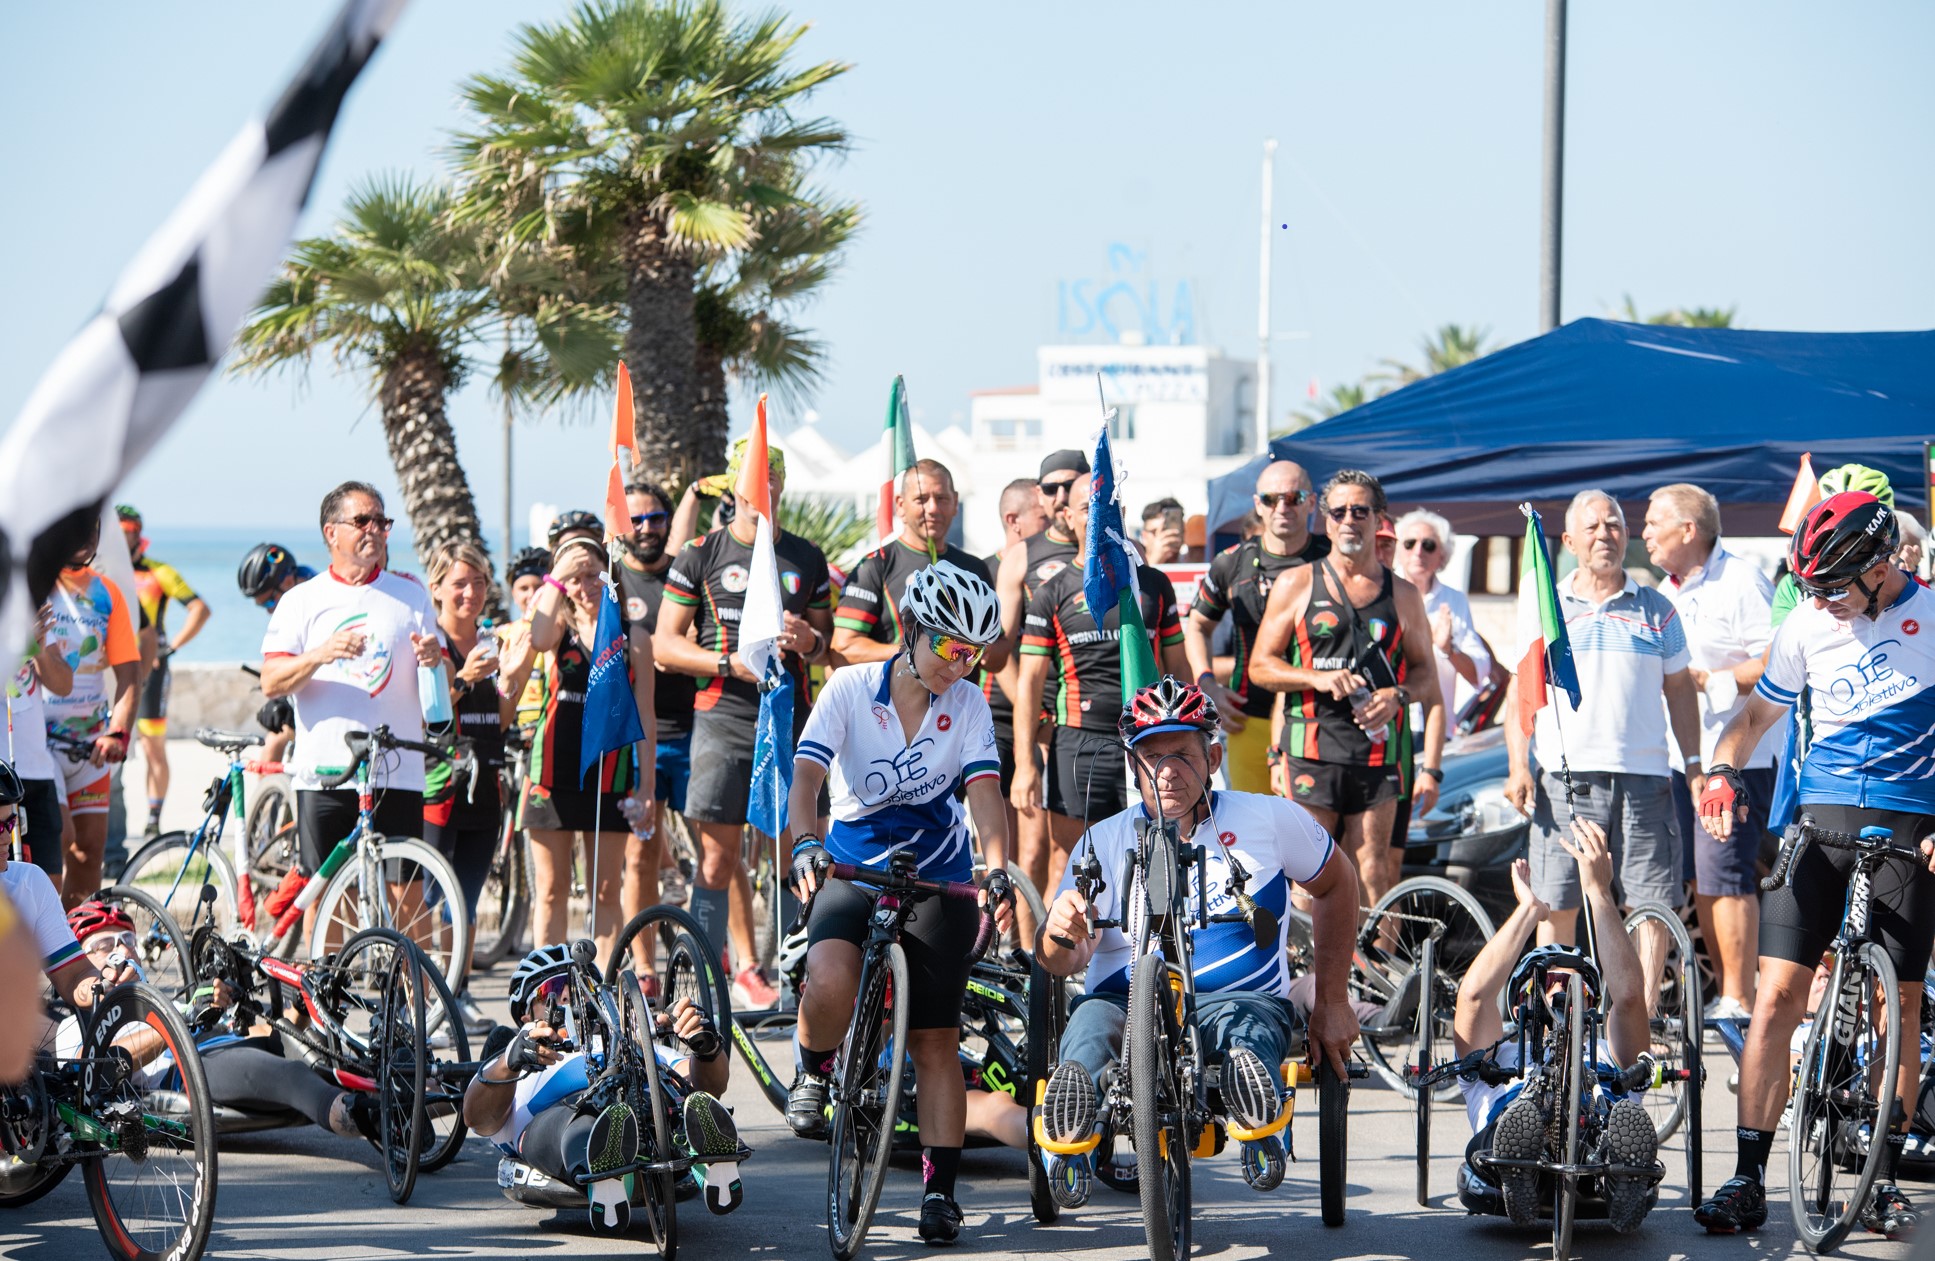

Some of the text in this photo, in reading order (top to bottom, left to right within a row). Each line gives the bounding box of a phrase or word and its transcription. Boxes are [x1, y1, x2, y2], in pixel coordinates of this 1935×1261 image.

[1865, 507, 1888, 536] KASK
[95, 1004, 122, 1043] END
[192, 1161, 203, 1227] TOP
